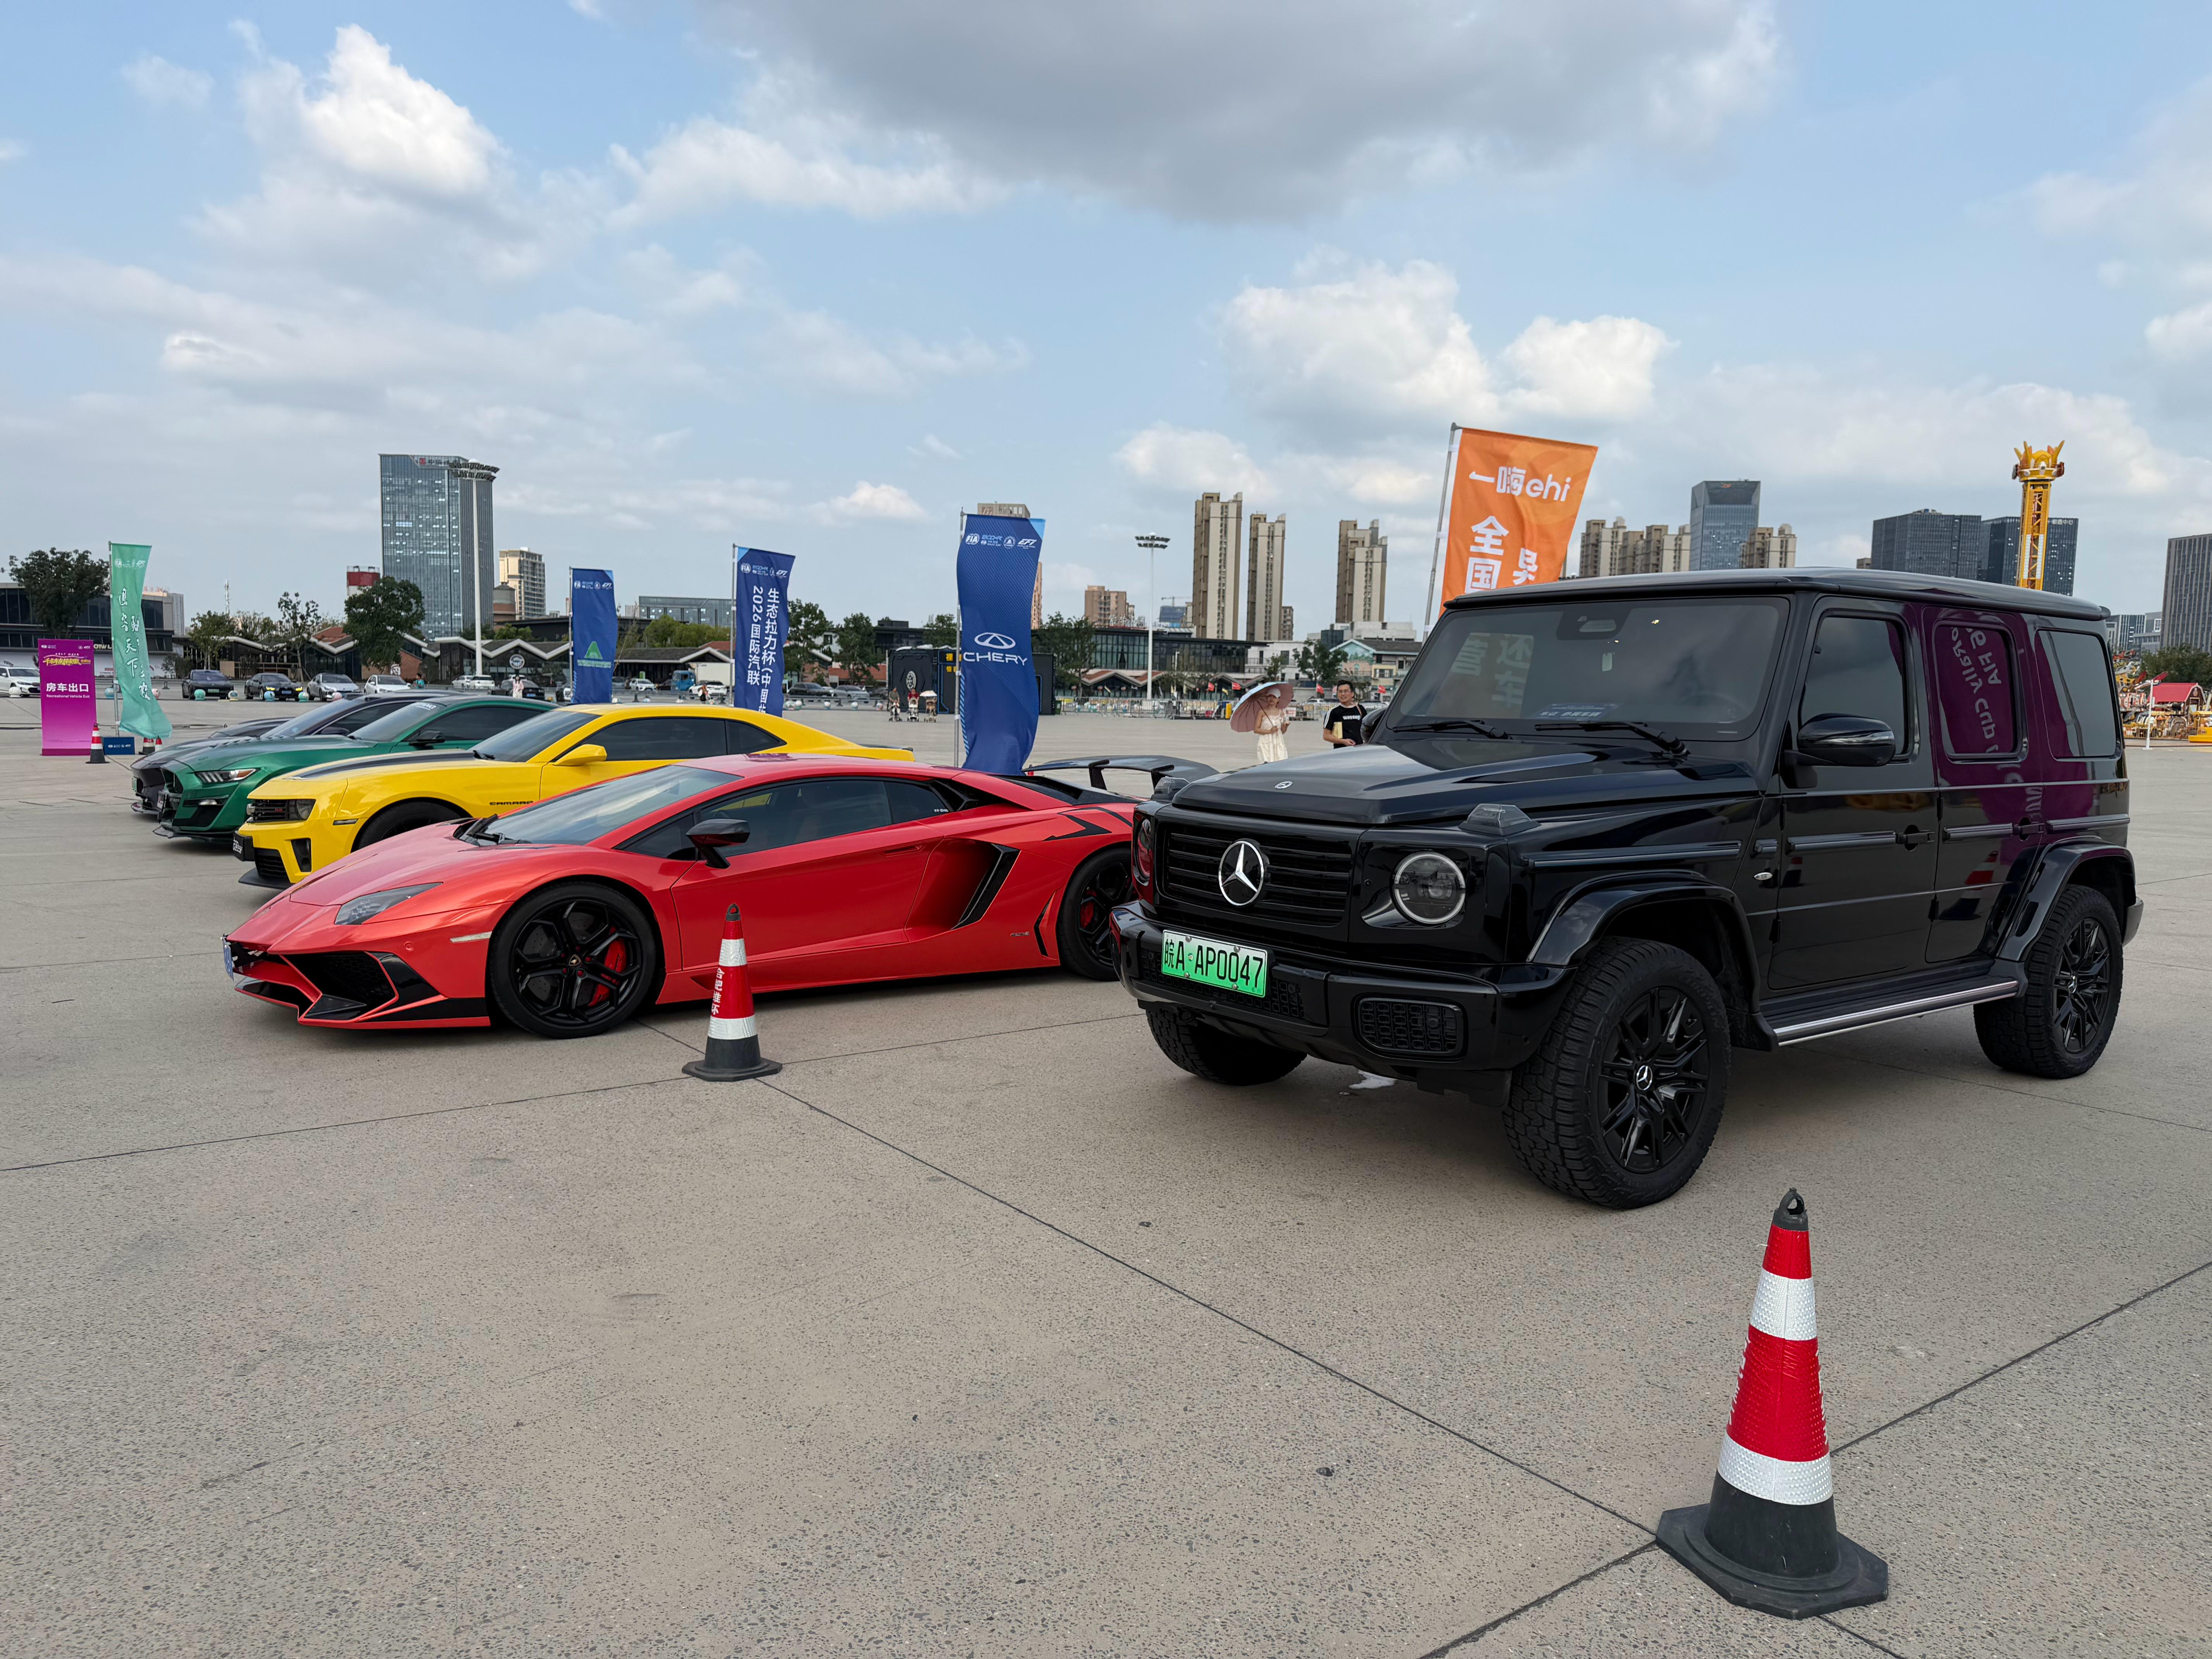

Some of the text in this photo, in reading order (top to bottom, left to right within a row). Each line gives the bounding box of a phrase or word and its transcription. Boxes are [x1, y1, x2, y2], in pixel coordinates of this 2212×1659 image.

[747, 585, 763, 686] 2026国际汽联
[963, 652, 1028, 666] CHERY
[46, 683, 89, 692] 房车出口
[1194, 945, 1263, 988] AP0047
